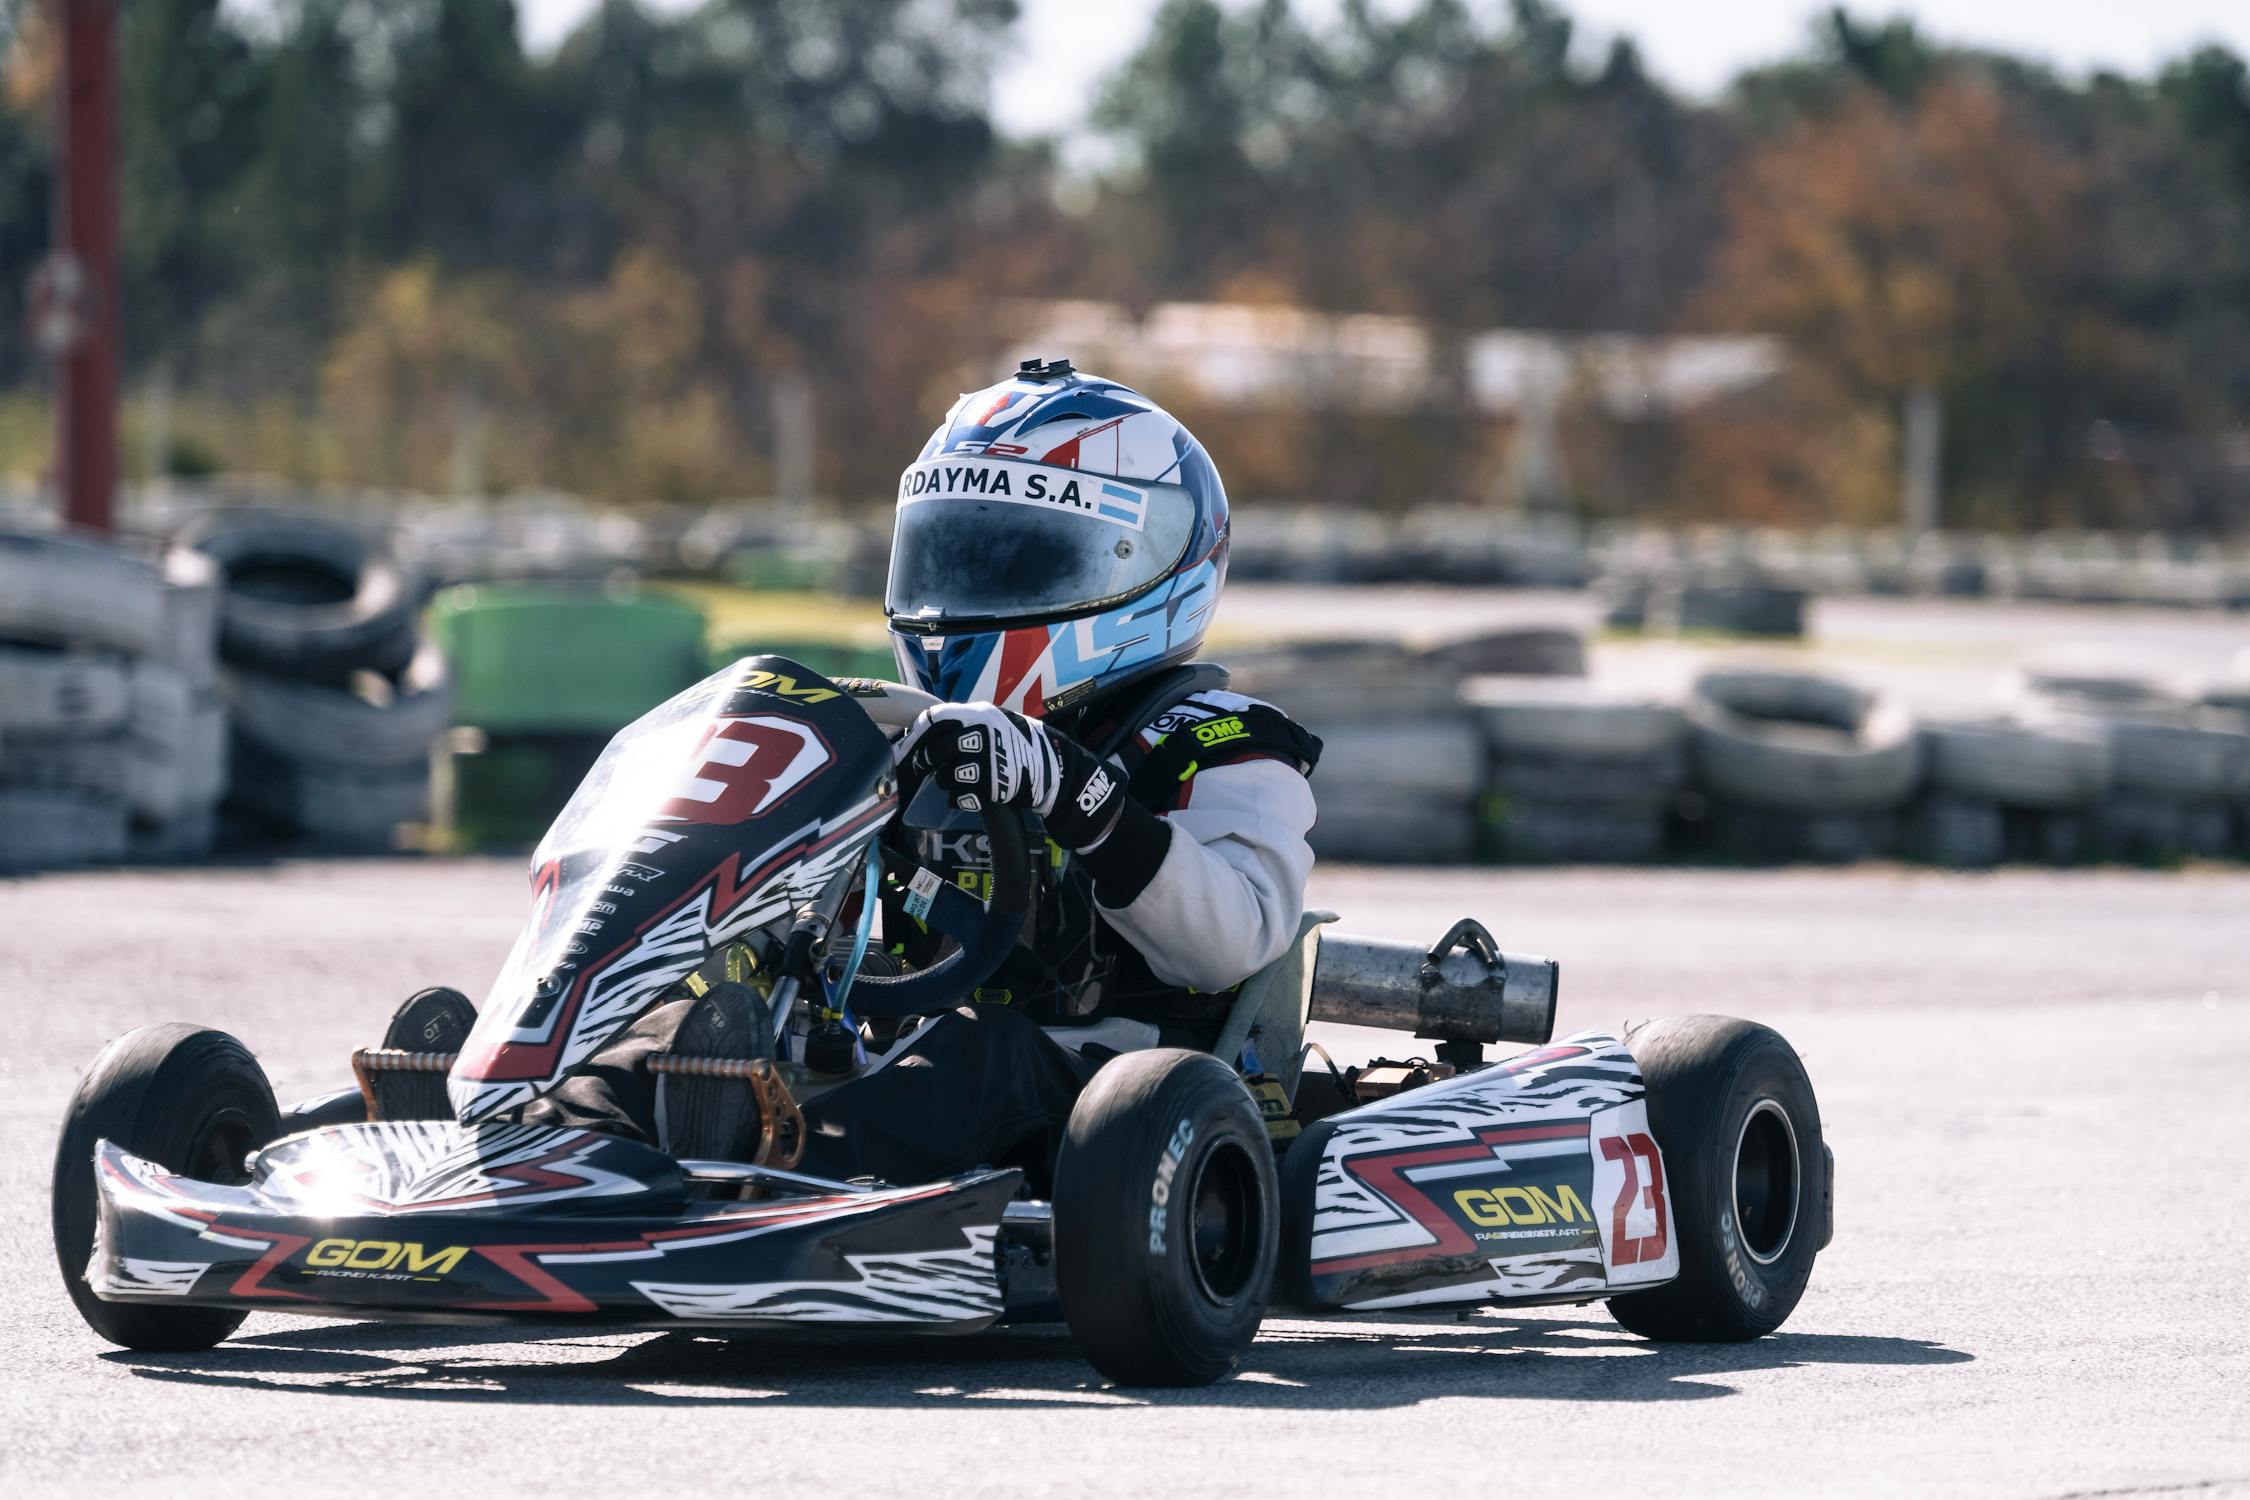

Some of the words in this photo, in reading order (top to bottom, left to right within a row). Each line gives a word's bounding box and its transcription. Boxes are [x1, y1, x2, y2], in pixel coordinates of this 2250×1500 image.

[1024, 473, 1092, 510] S.A.
[738, 670, 843, 704] OM
[1193, 717, 1249, 745] OMP
[656, 720, 806, 825] 3
[1078, 768, 1114, 814] OMP
[1599, 1132, 1667, 1267] 23
[367, 1273, 413, 1281] KART
